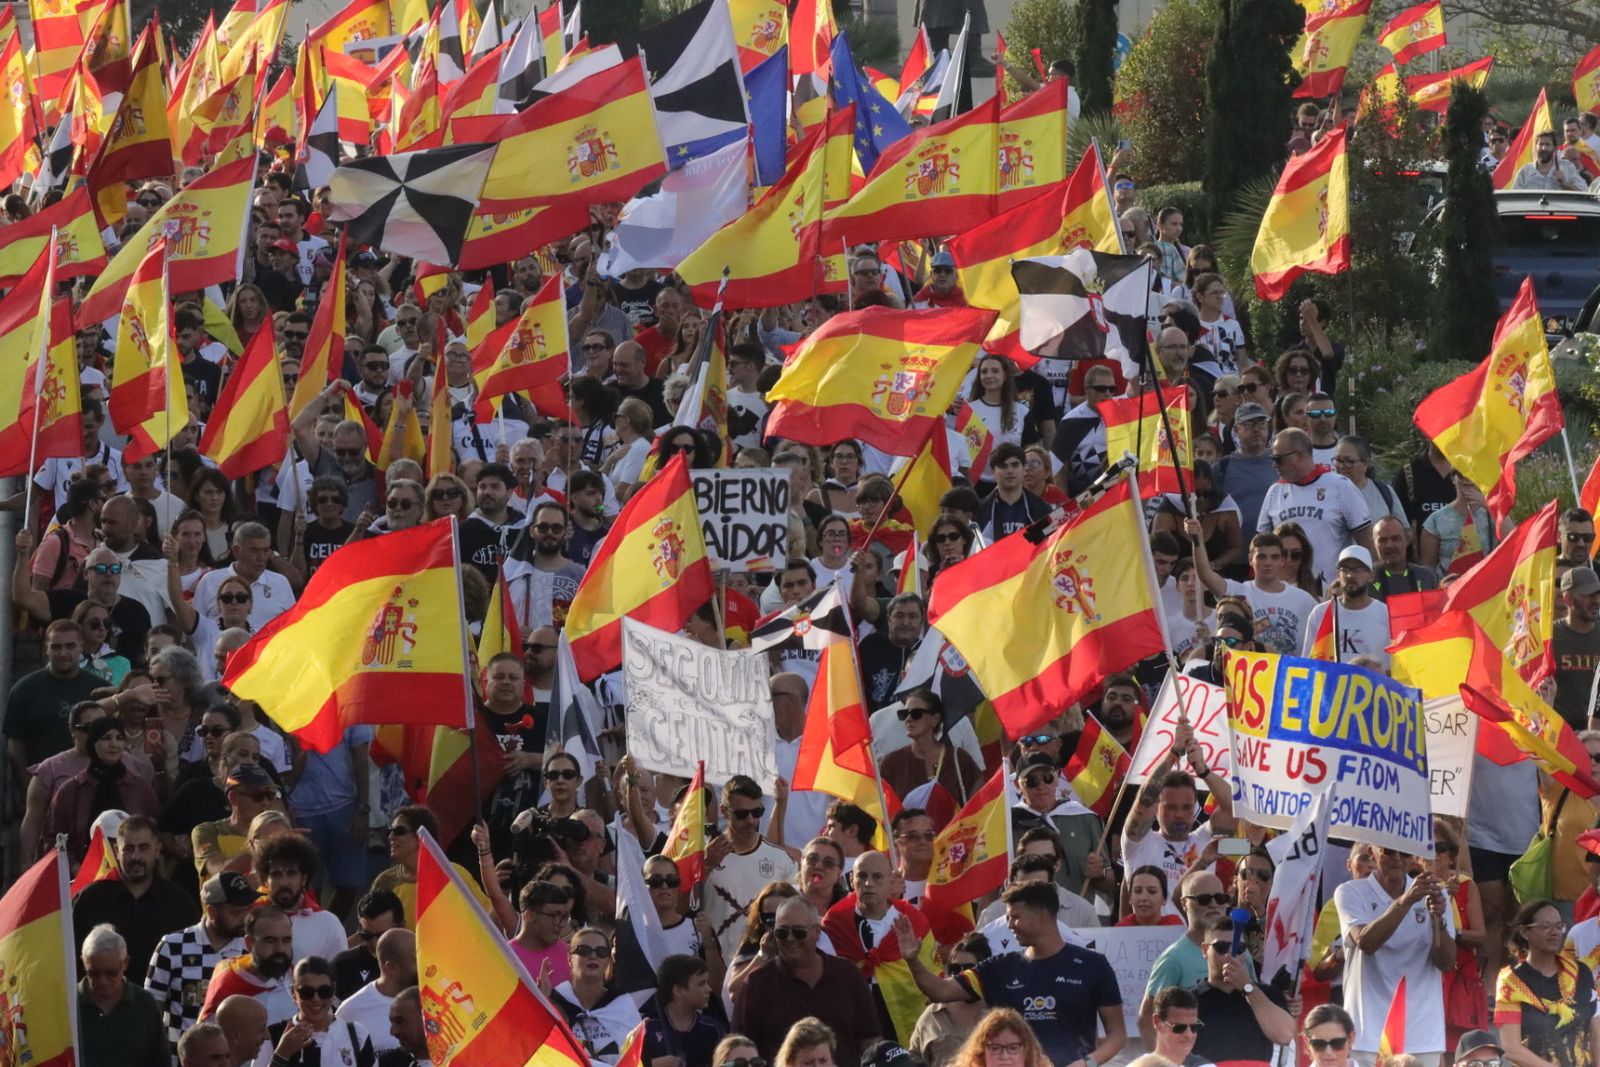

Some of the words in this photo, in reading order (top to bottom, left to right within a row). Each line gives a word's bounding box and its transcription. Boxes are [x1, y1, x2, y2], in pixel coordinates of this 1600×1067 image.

[693, 472, 789, 516] BIERNO
[1278, 506, 1325, 521] CEUTA
[702, 515, 787, 562] AIDOR
[626, 631, 772, 705] SEGOVIA
[1161, 675, 1228, 737] 202
[1281, 667, 1425, 771] EUROPE!
[1286, 747, 1327, 784] US
[1337, 754, 1399, 793] FROM
[1022, 995, 1056, 1011] 200
